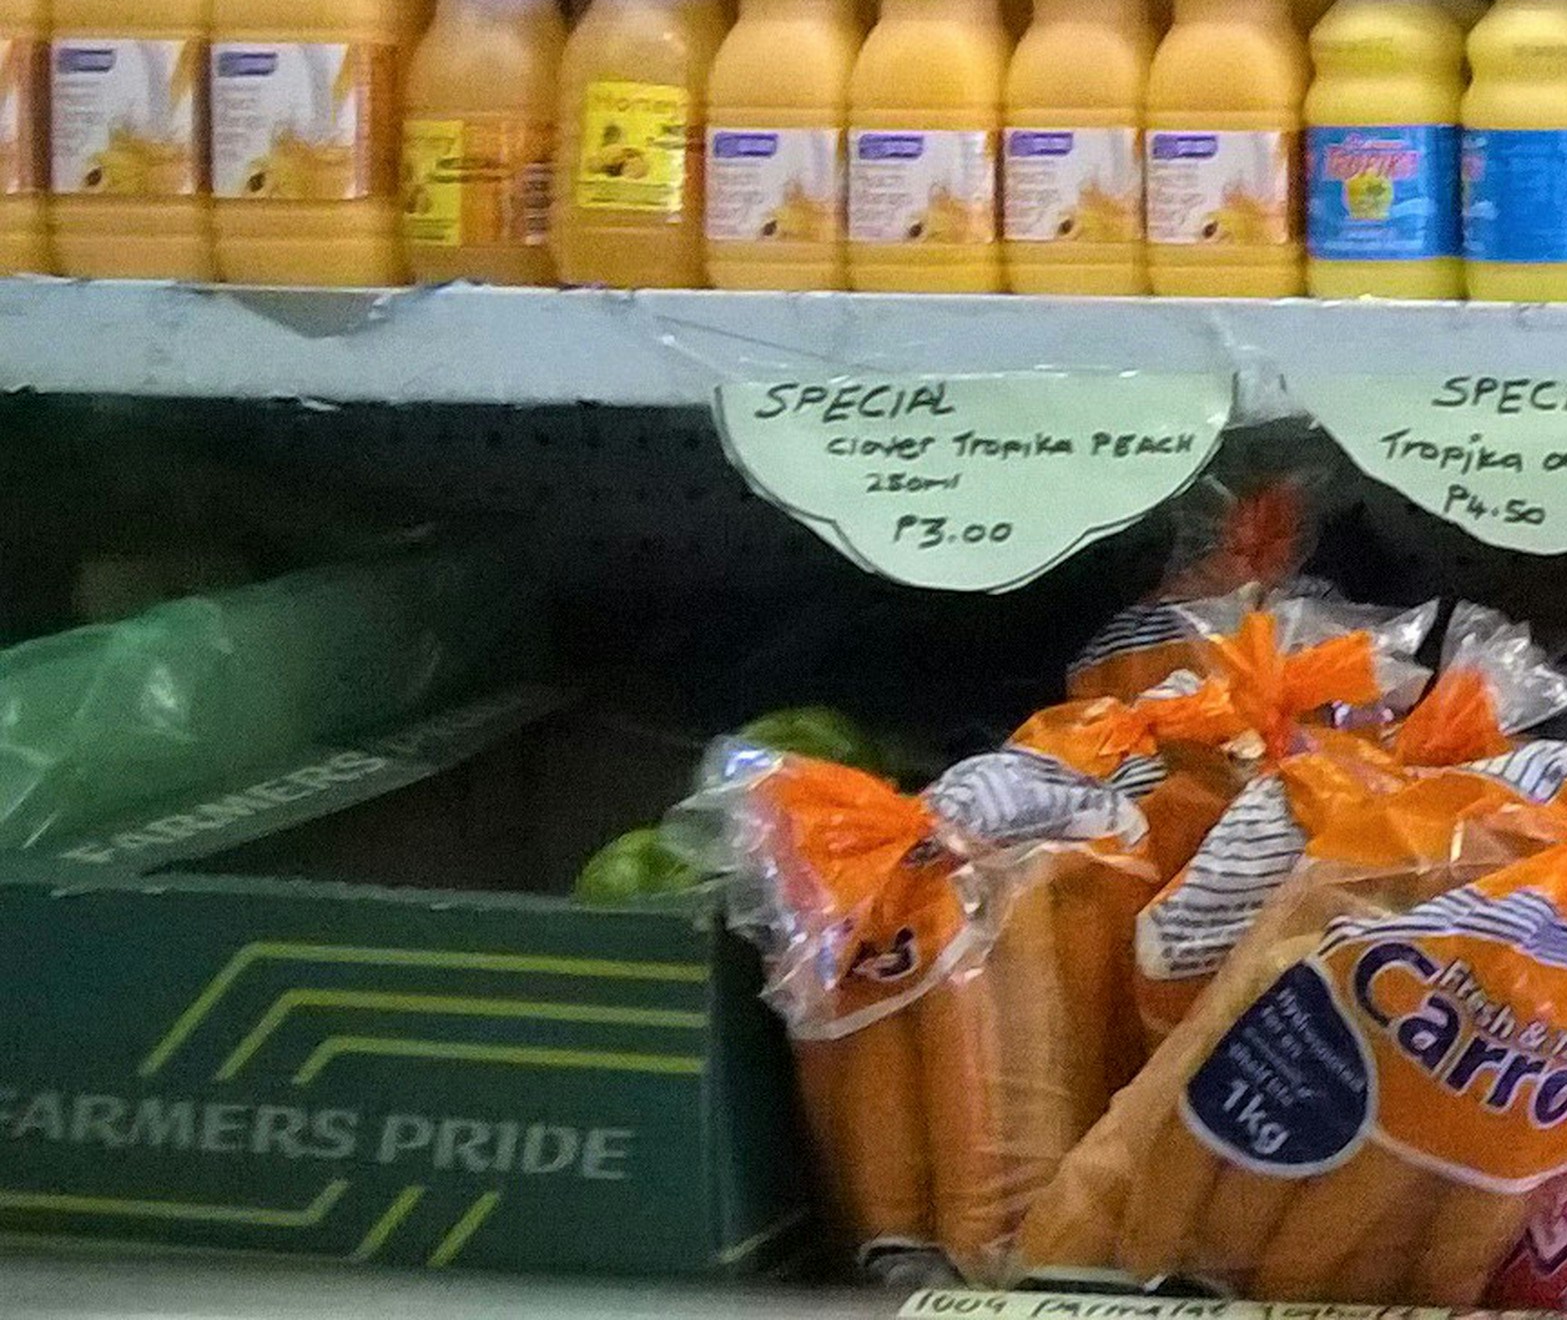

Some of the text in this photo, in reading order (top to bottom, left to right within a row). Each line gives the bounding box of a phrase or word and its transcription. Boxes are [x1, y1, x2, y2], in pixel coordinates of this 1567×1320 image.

[754, 382, 957, 424] SPECIAL
[1443, 483, 1547, 526] P4.50
[893, 515, 1015, 549] P3.00
[374, 1114, 638, 1182] PRIDE
